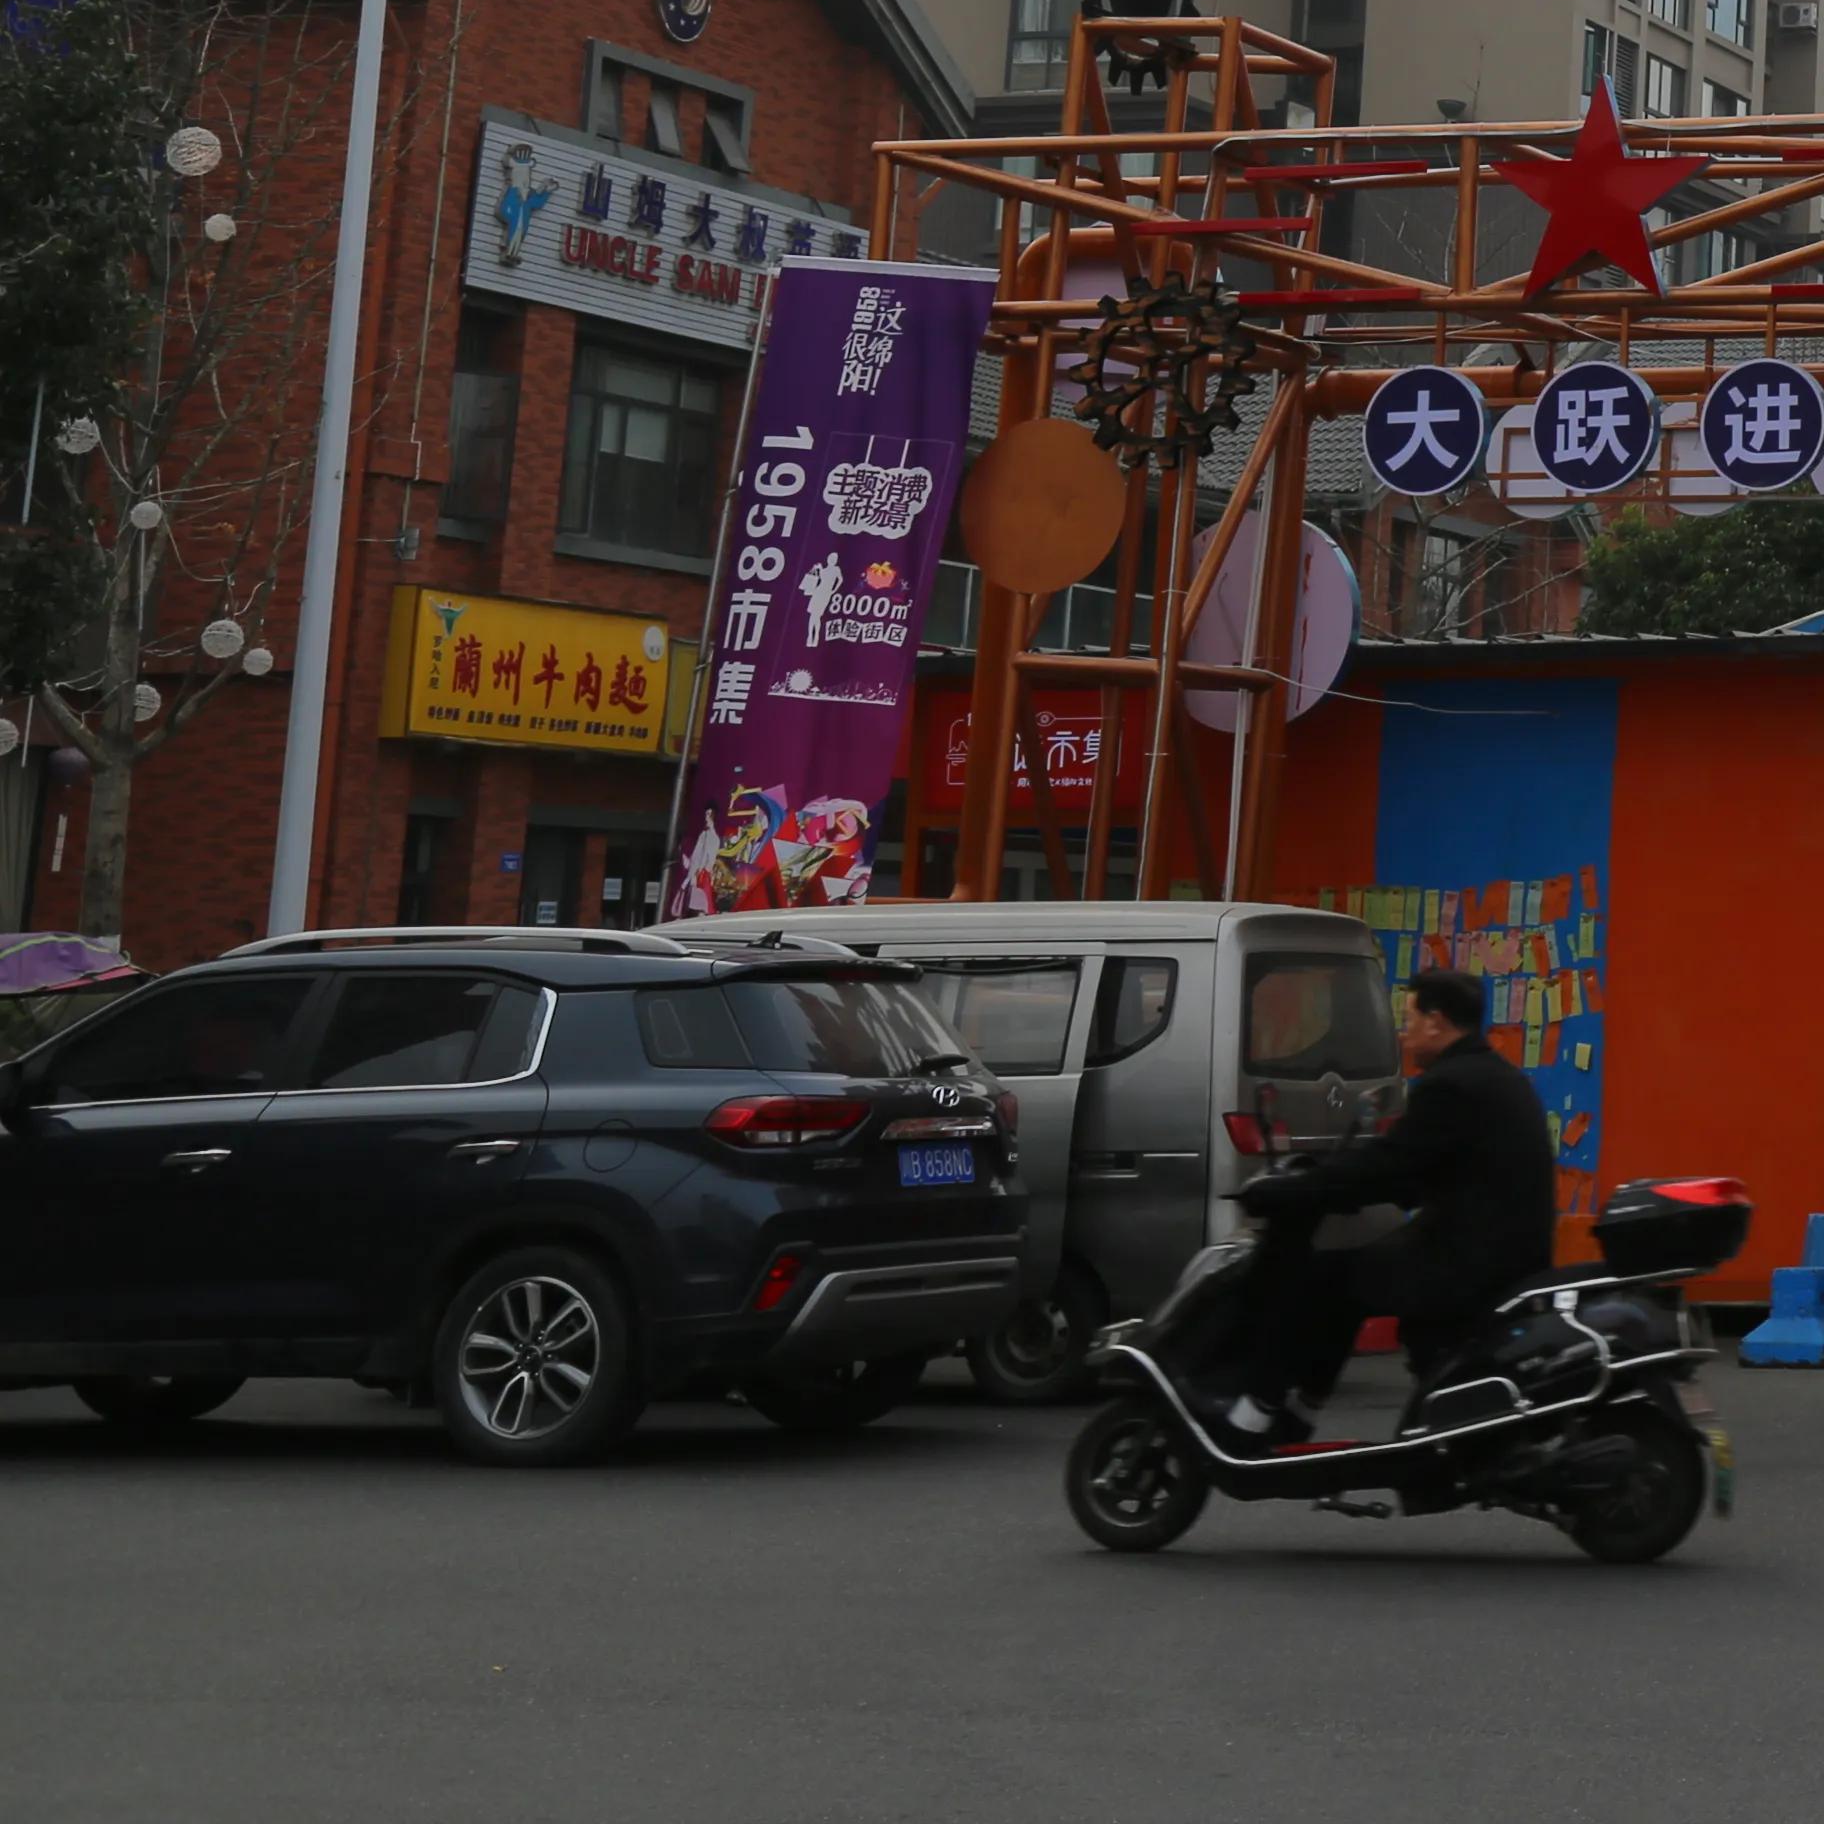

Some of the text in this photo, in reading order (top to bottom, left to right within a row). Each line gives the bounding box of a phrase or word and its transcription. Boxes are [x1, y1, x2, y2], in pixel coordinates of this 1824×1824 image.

[563, 224, 662, 286] UNCLE
[673, 253, 742, 306] SAM
[1385, 380, 1803, 472] 大跃进
[828, 467, 927, 503] 主题消费
[839, 499, 911, 530] 新场景
